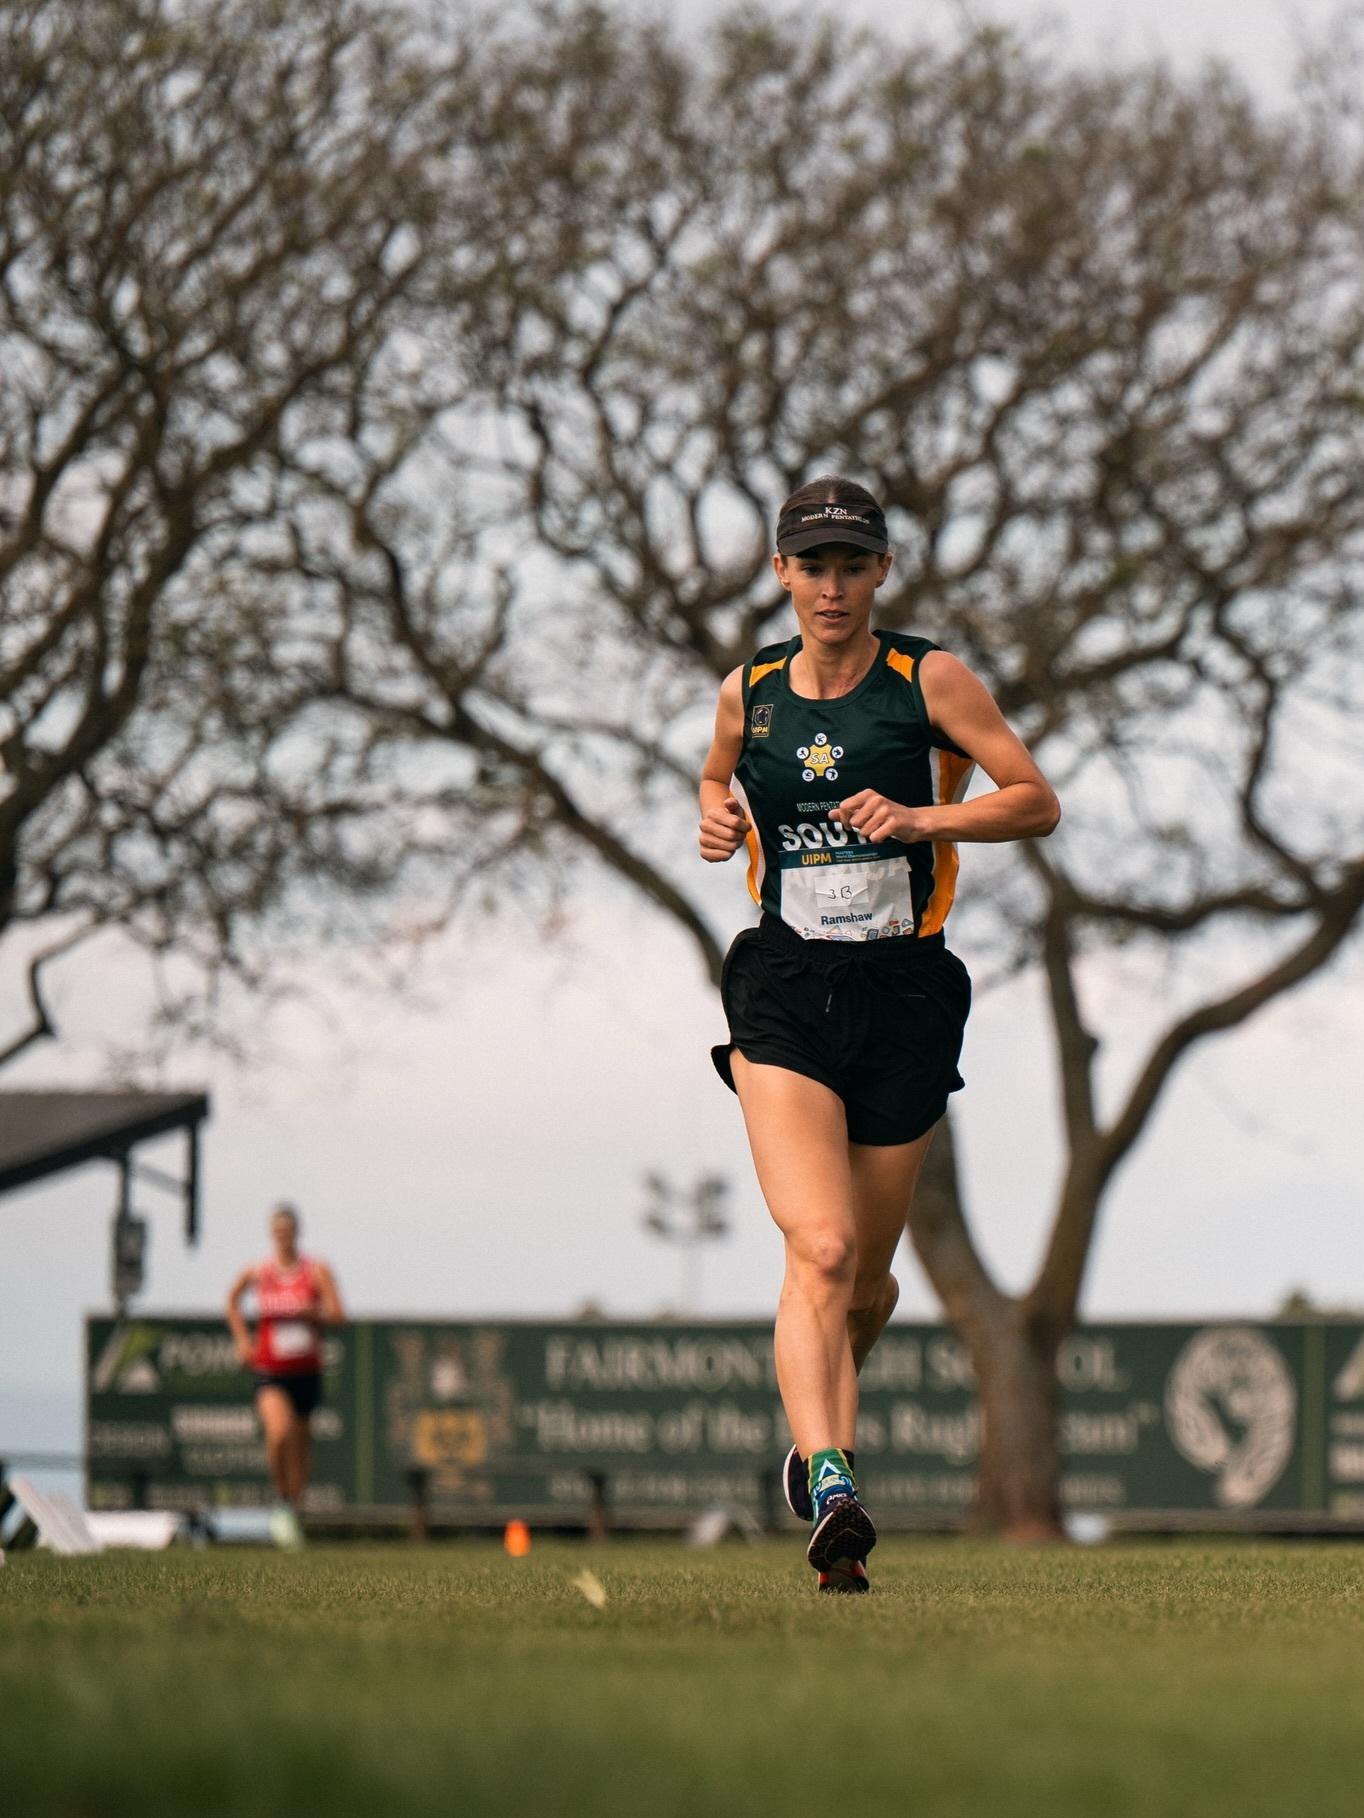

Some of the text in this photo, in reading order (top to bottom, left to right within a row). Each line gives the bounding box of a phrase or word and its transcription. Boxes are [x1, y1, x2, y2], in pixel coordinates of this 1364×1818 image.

[825, 506, 848, 515] KZN
[801, 512, 829, 523] MODERN
[811, 752, 830, 765] SA
[796, 800, 841, 813] MODERN PENTAT
[777, 821, 868, 851] SOU
[801, 852, 833, 866] UIPM
[820, 912, 874, 926] Ramshaw
